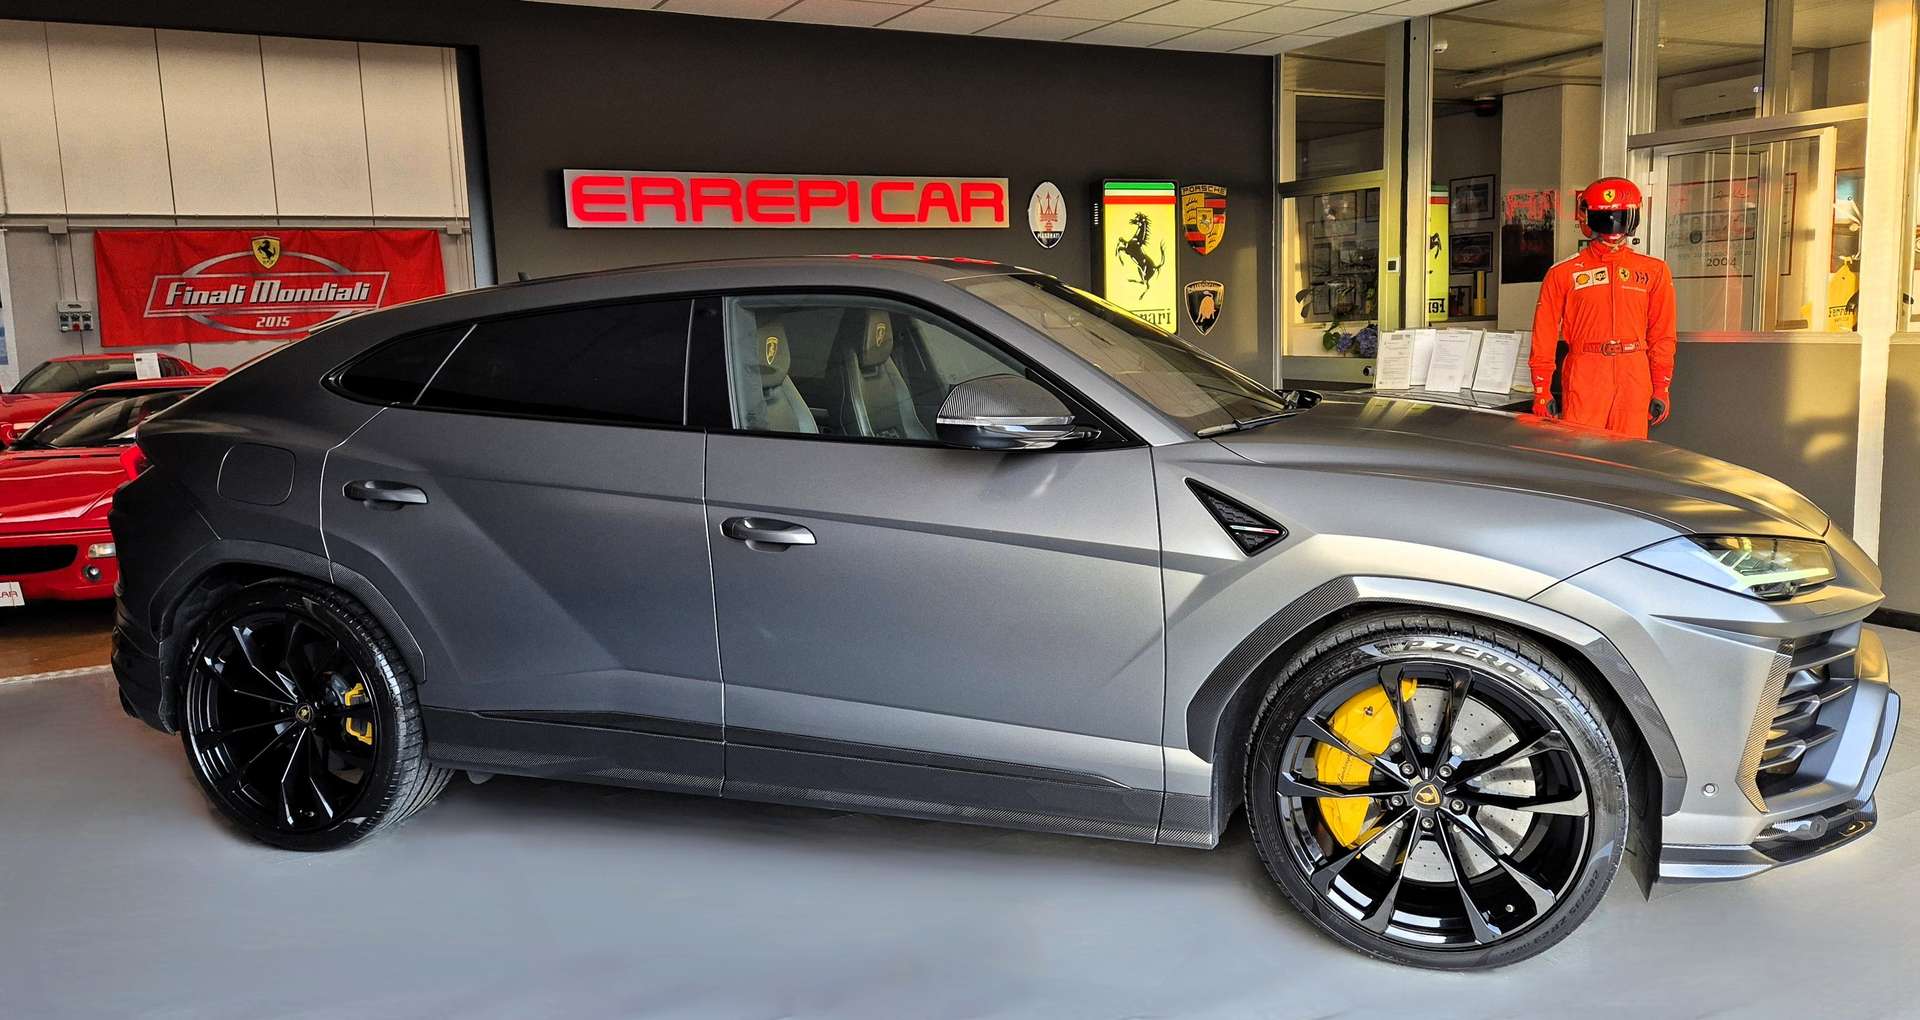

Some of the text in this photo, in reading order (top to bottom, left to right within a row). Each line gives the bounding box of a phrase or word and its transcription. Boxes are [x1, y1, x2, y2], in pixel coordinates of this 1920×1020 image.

[572, 175, 1005, 224] ERREPI CAR
[1182, 185, 1227, 195] PORSCHE
[1706, 257, 1737, 268] 2004
[165, 279, 371, 305] Finali Mondiali
[256, 315, 292, 328] 2015
[1430, 641, 1524, 678] ZERO
